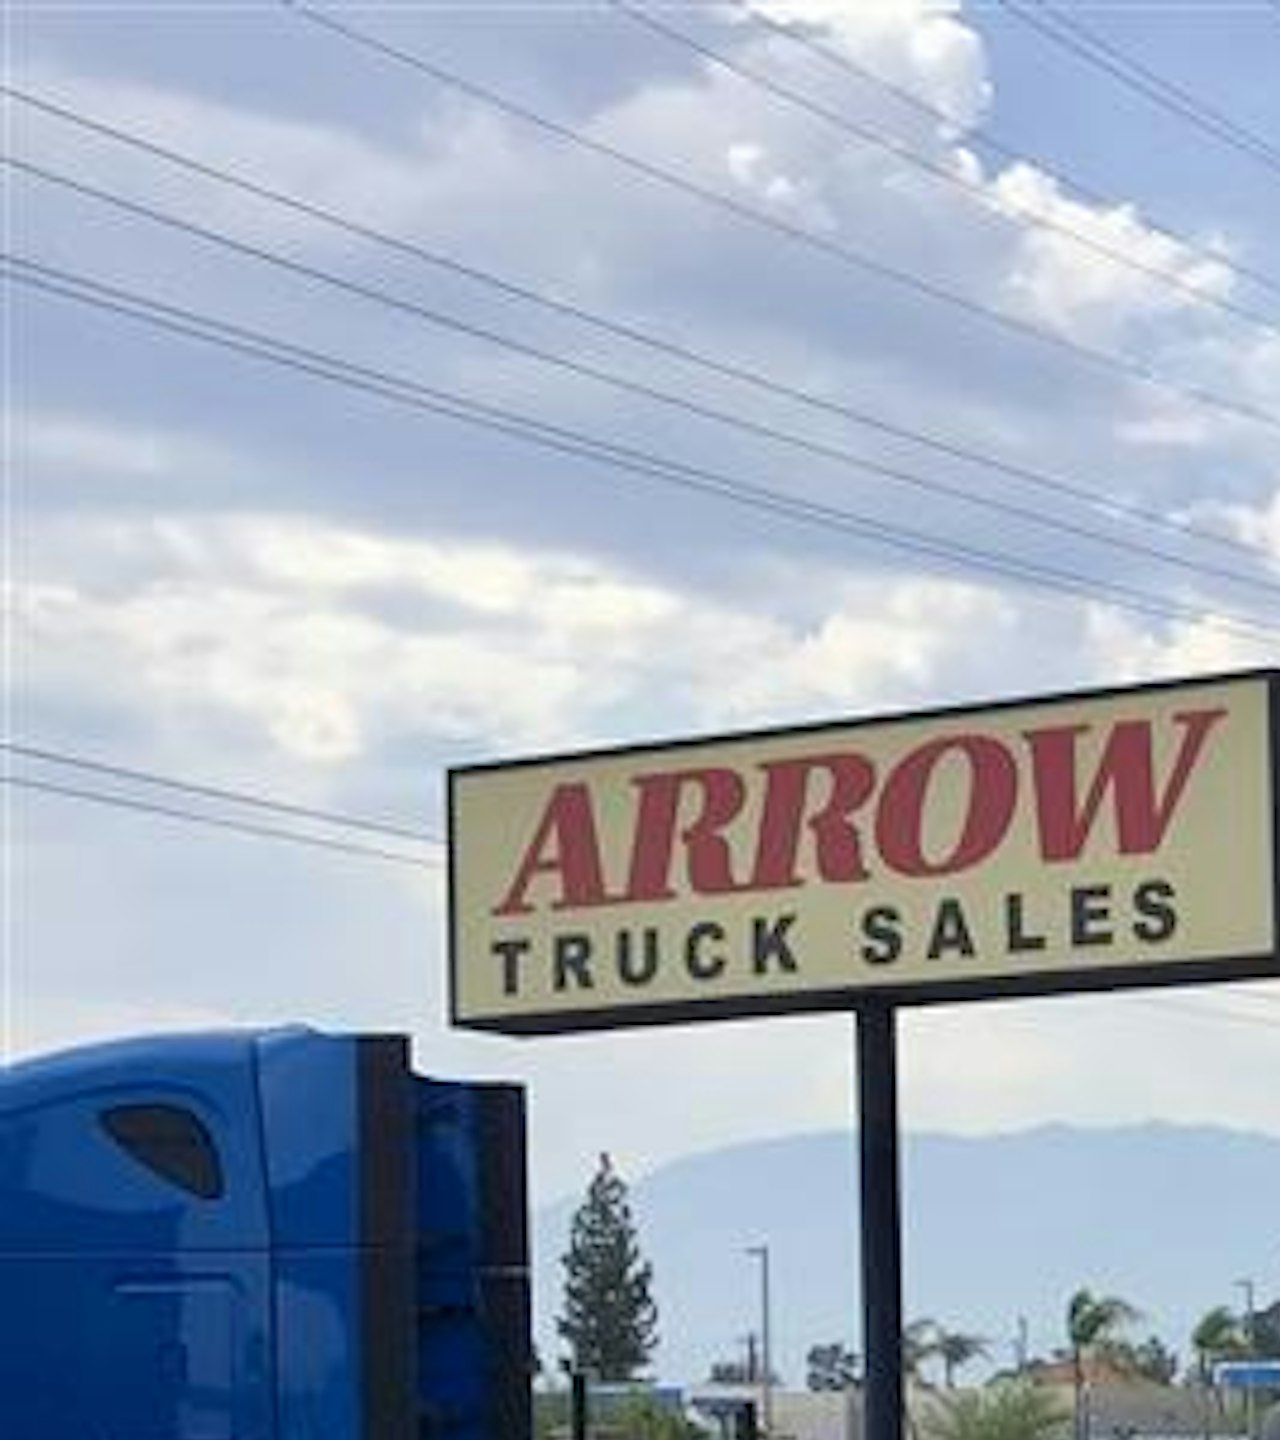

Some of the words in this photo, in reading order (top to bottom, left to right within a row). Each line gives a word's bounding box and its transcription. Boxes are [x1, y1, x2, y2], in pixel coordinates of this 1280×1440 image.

[492, 708, 1227, 916] ARROW
[489, 913, 799, 997] TRUCK
[859, 879, 1180, 967] SALES
